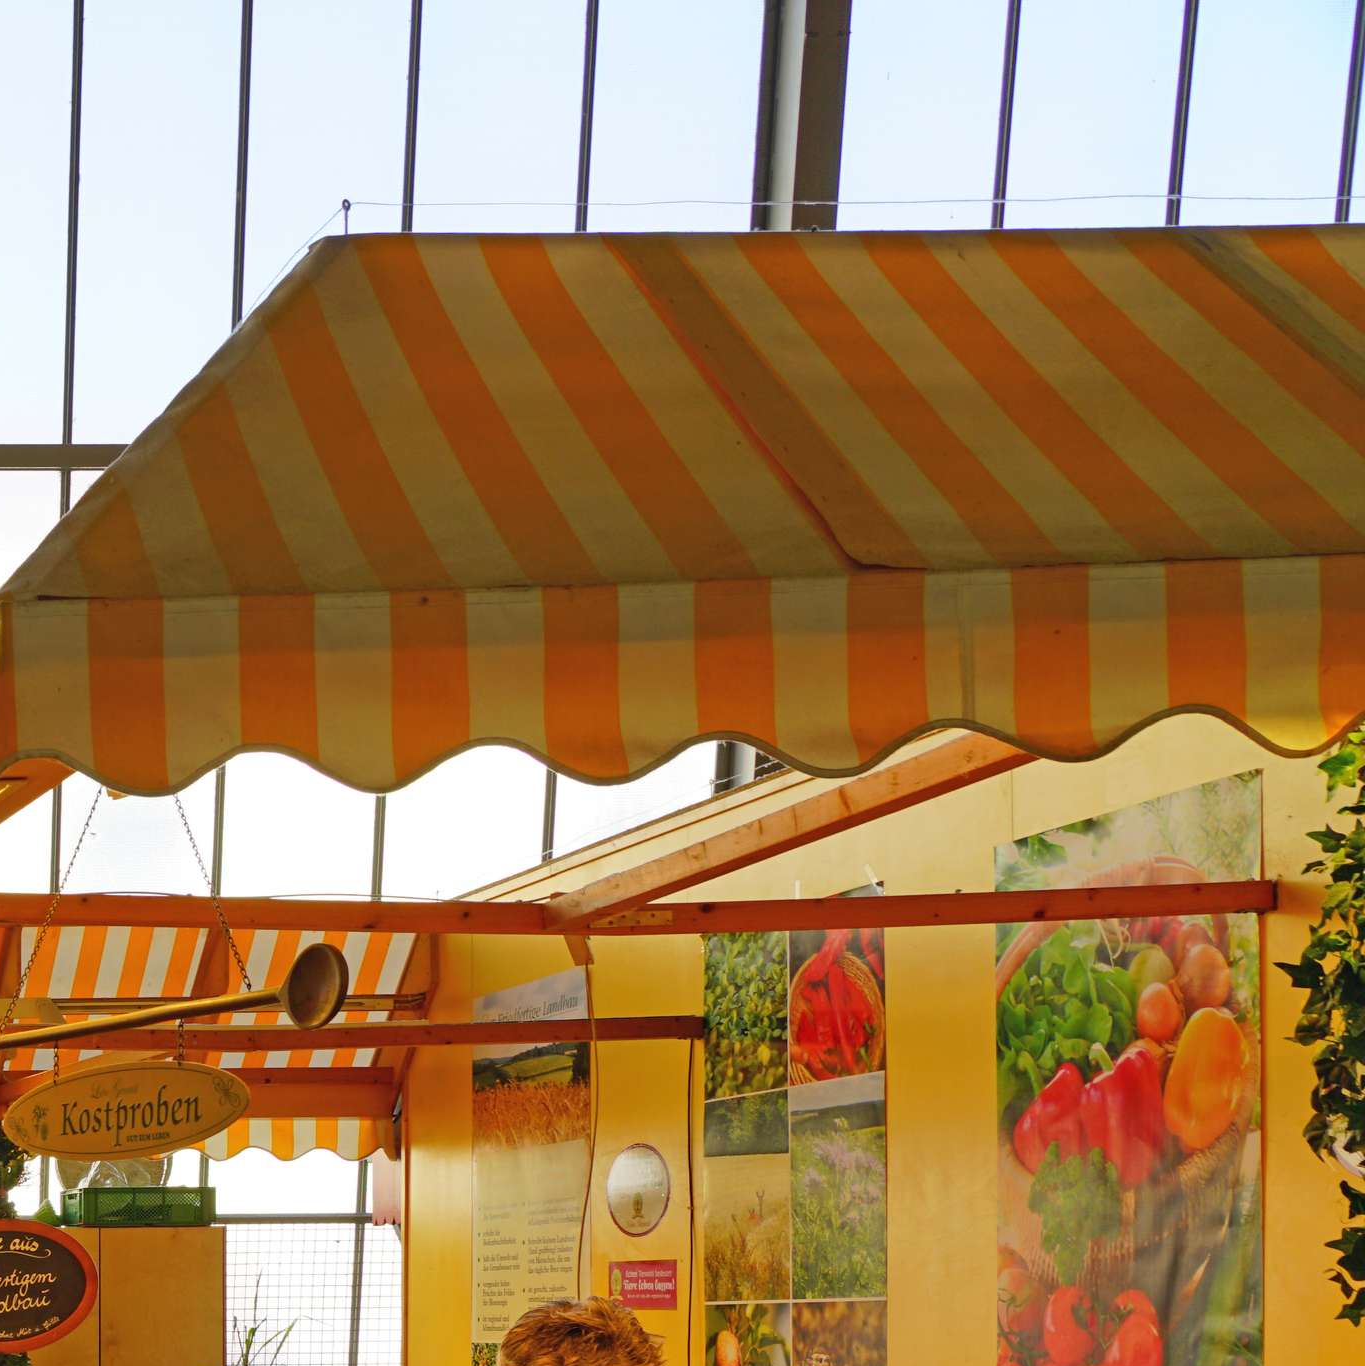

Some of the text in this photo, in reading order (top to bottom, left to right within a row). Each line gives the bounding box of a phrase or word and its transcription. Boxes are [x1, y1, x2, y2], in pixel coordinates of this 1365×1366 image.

[542, 995, 578, 1016] Landbau
[61, 1084, 203, 1147] Kostproben
[10, 1236, 40, 1252] aus
